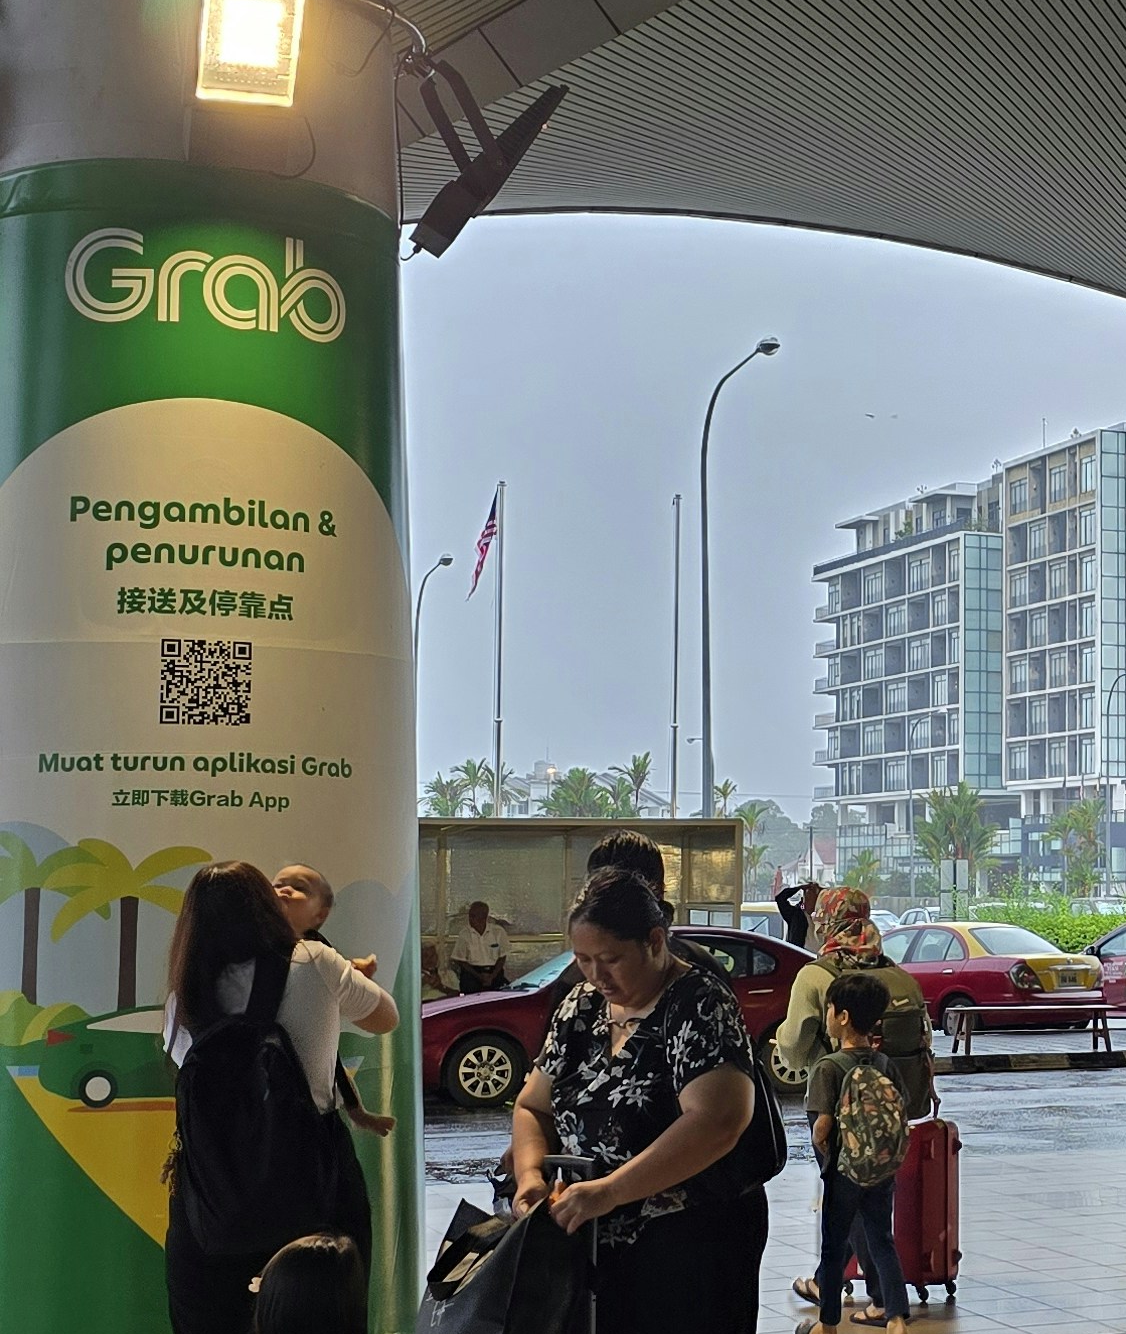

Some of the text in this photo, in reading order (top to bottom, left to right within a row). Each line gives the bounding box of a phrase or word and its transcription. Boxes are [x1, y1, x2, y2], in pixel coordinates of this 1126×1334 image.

[64, 227, 347, 344] Grab
[69, 495, 338, 538] Pengambilan &
[105, 542, 306, 573] penurunan
[116, 586, 295, 621] 接送及停靠点
[38, 751, 354, 779] Muat turun aplikasi Grab
[248, 791, 291, 813] App
